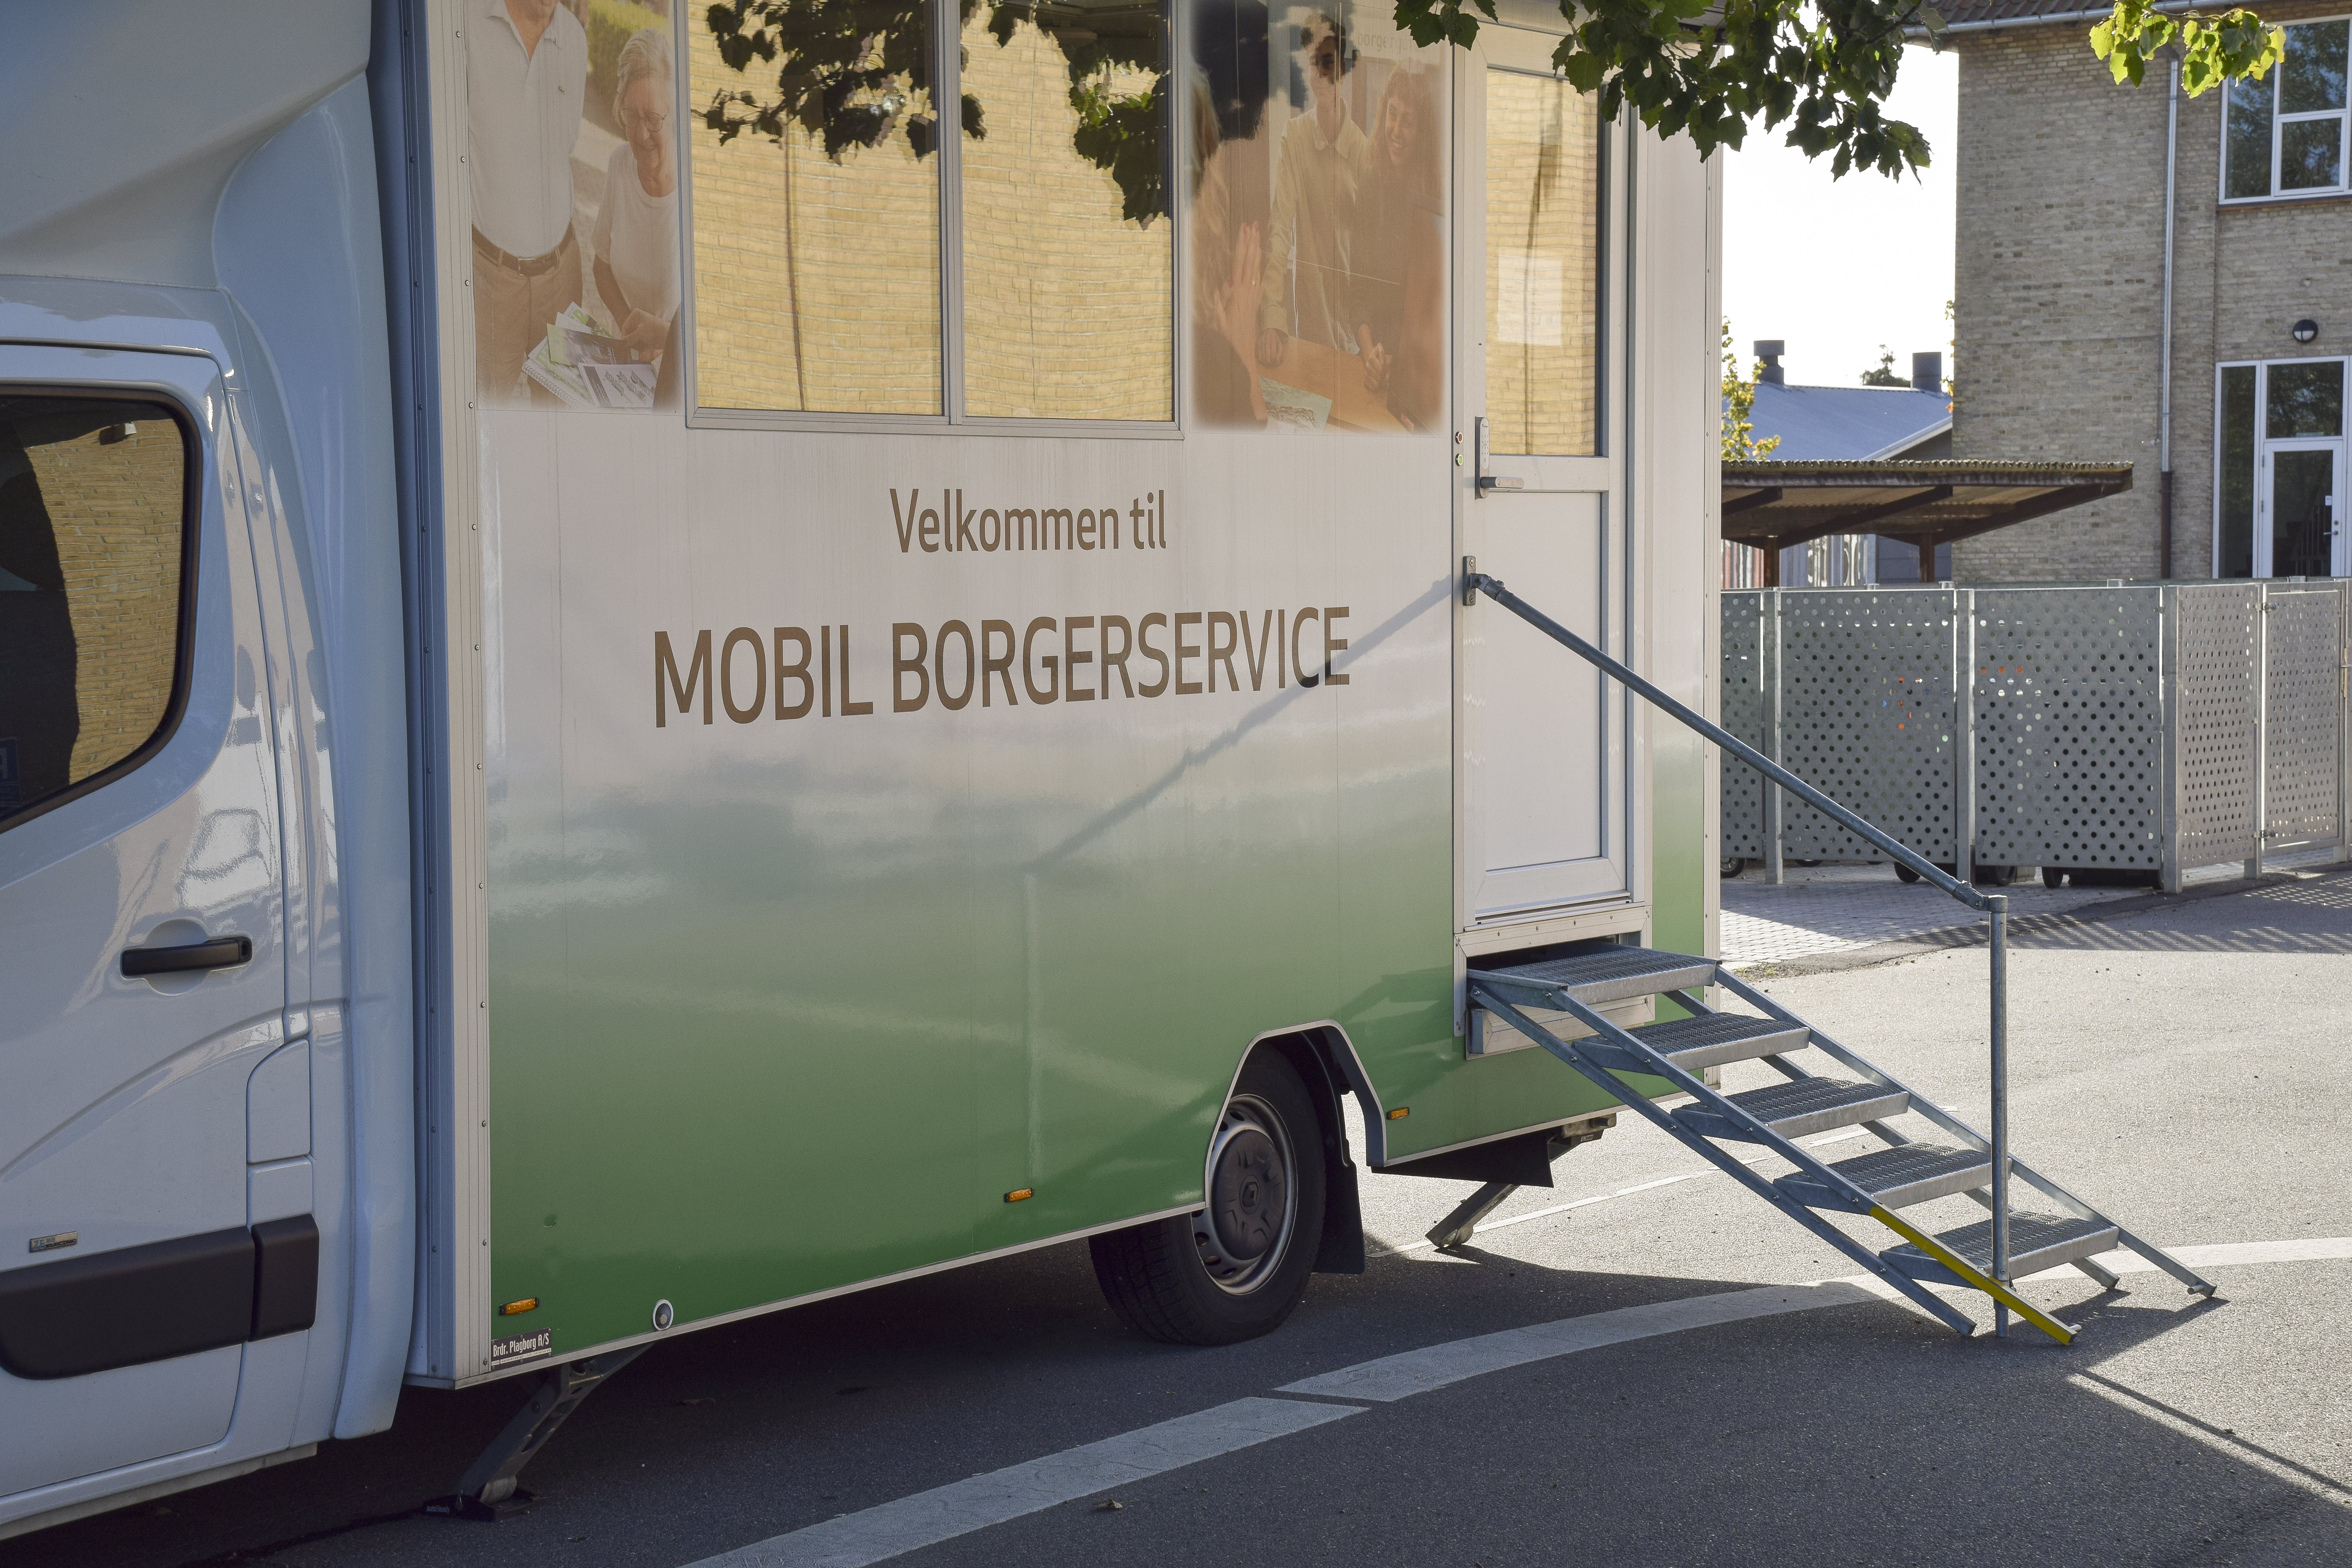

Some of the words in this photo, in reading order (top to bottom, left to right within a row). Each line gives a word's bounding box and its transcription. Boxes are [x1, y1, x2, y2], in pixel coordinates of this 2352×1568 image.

[890, 488, 1119, 553] Velkommen
[1129, 489, 1166, 550] til
[654, 624, 874, 728] MOBIL
[892, 605, 1350, 713] BORGERSERVICE
[46, 1239, 77, 1248] ELECTRIC
[493, 1343, 508, 1357] Brdr.
[510, 1338, 536, 1353] Plagborg
[538, 1333, 549, 1347] A/S
[427, 1505, 450, 1514] autoSteady
